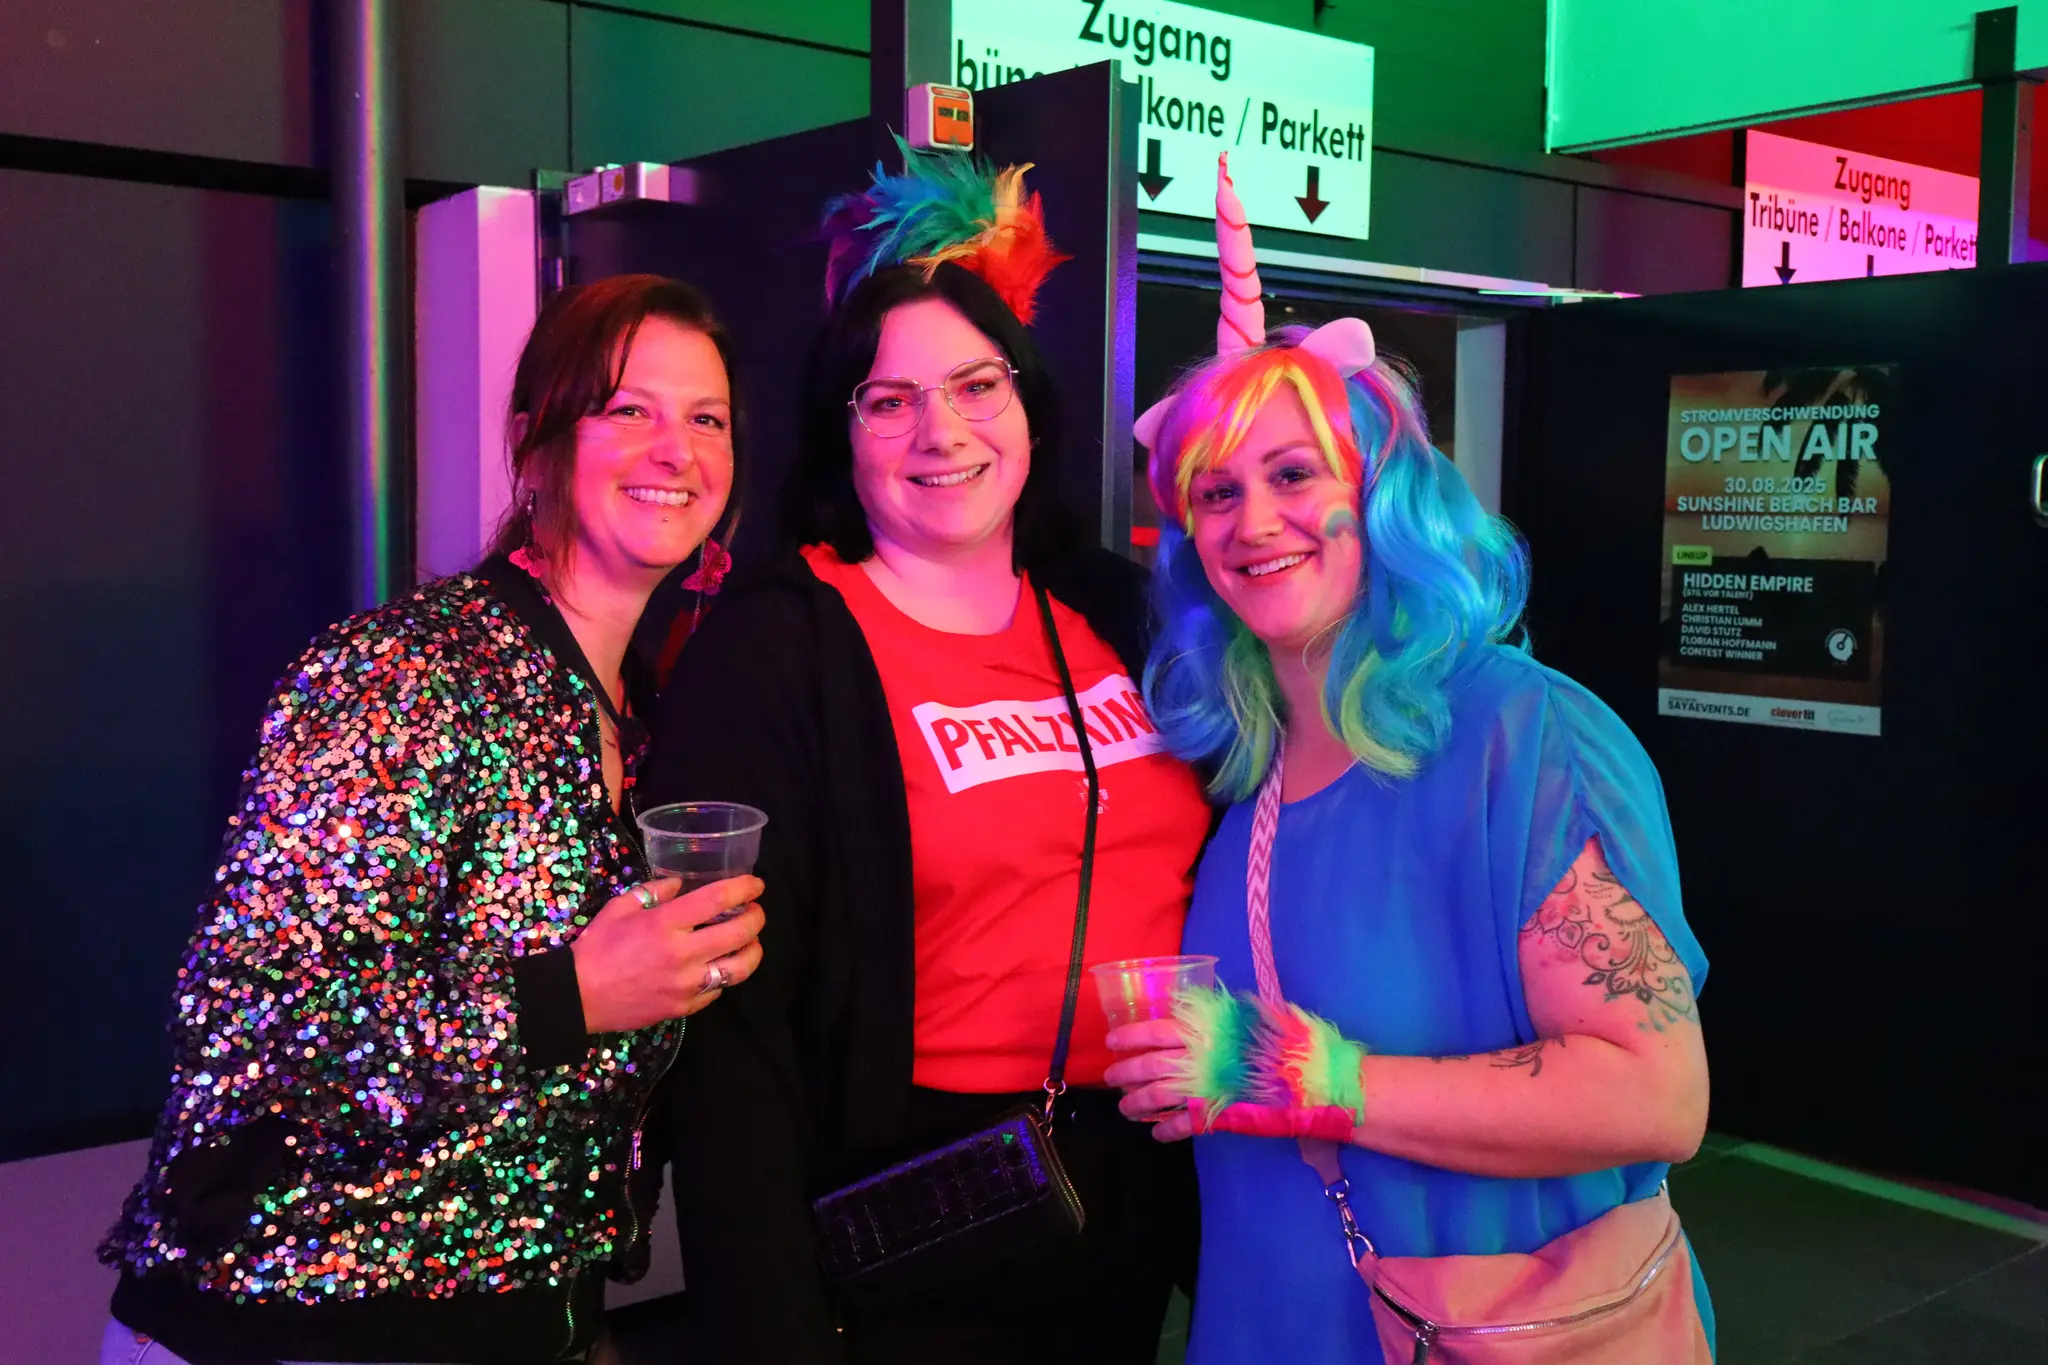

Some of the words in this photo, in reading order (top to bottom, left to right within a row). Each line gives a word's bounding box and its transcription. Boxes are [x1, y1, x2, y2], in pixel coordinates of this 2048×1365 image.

[1078, 0, 1232, 81] Zugang
[1139, 75, 1225, 138] lkone
[1262, 101, 1366, 163] Parkett
[1834, 155, 1911, 211] Zugang
[1750, 192, 1819, 237] Tribüne
[1824, 205, 1835, 243] /
[1840, 208, 1906, 252] Balkone
[1911, 220, 1921, 257] /
[1925, 223, 1977, 262] Parket
[1680, 404, 1880, 424] STROMVERSCHWENDUNG
[1680, 424, 1792, 462] OPEN
[1802, 423, 1879, 461] AIR
[1724, 476, 1827, 495] 30.08.2025
[1677, 496, 1765, 513] SUNSHINE
[1770, 497, 1833, 514] BEACH
[1838, 497, 1878, 514] BAR
[1702, 514, 1848, 533] LUDWIGSHAFEN
[1676, 551, 1708, 561] LINEUP
[1683, 573, 1747, 590] HIDDEN
[1751, 575, 1814, 593] EMPIRE
[1703, 590, 1719, 598] VOR
[1721, 590, 1754, 600] TALENT)
[1682, 603, 1705, 613] ALEX
[1707, 604, 1740, 615] HERTEL
[1681, 614, 1732, 625] CHRISTIAN
[1733, 616, 1763, 627] LUMM
[1681, 625, 1711, 635] DAVID
[1712, 626, 1742, 636] STUTZ
[1681, 635, 1720, 646] FLORIAN
[1721, 638, 1777, 650] HOFFMANN
[1680, 647, 1723, 658] CONTEST
[1725, 650, 1764, 661] WINNER
[1667, 699, 1751, 717] SAYAEVENTS.DE
[930, 690, 1161, 771] PFALZKIN
